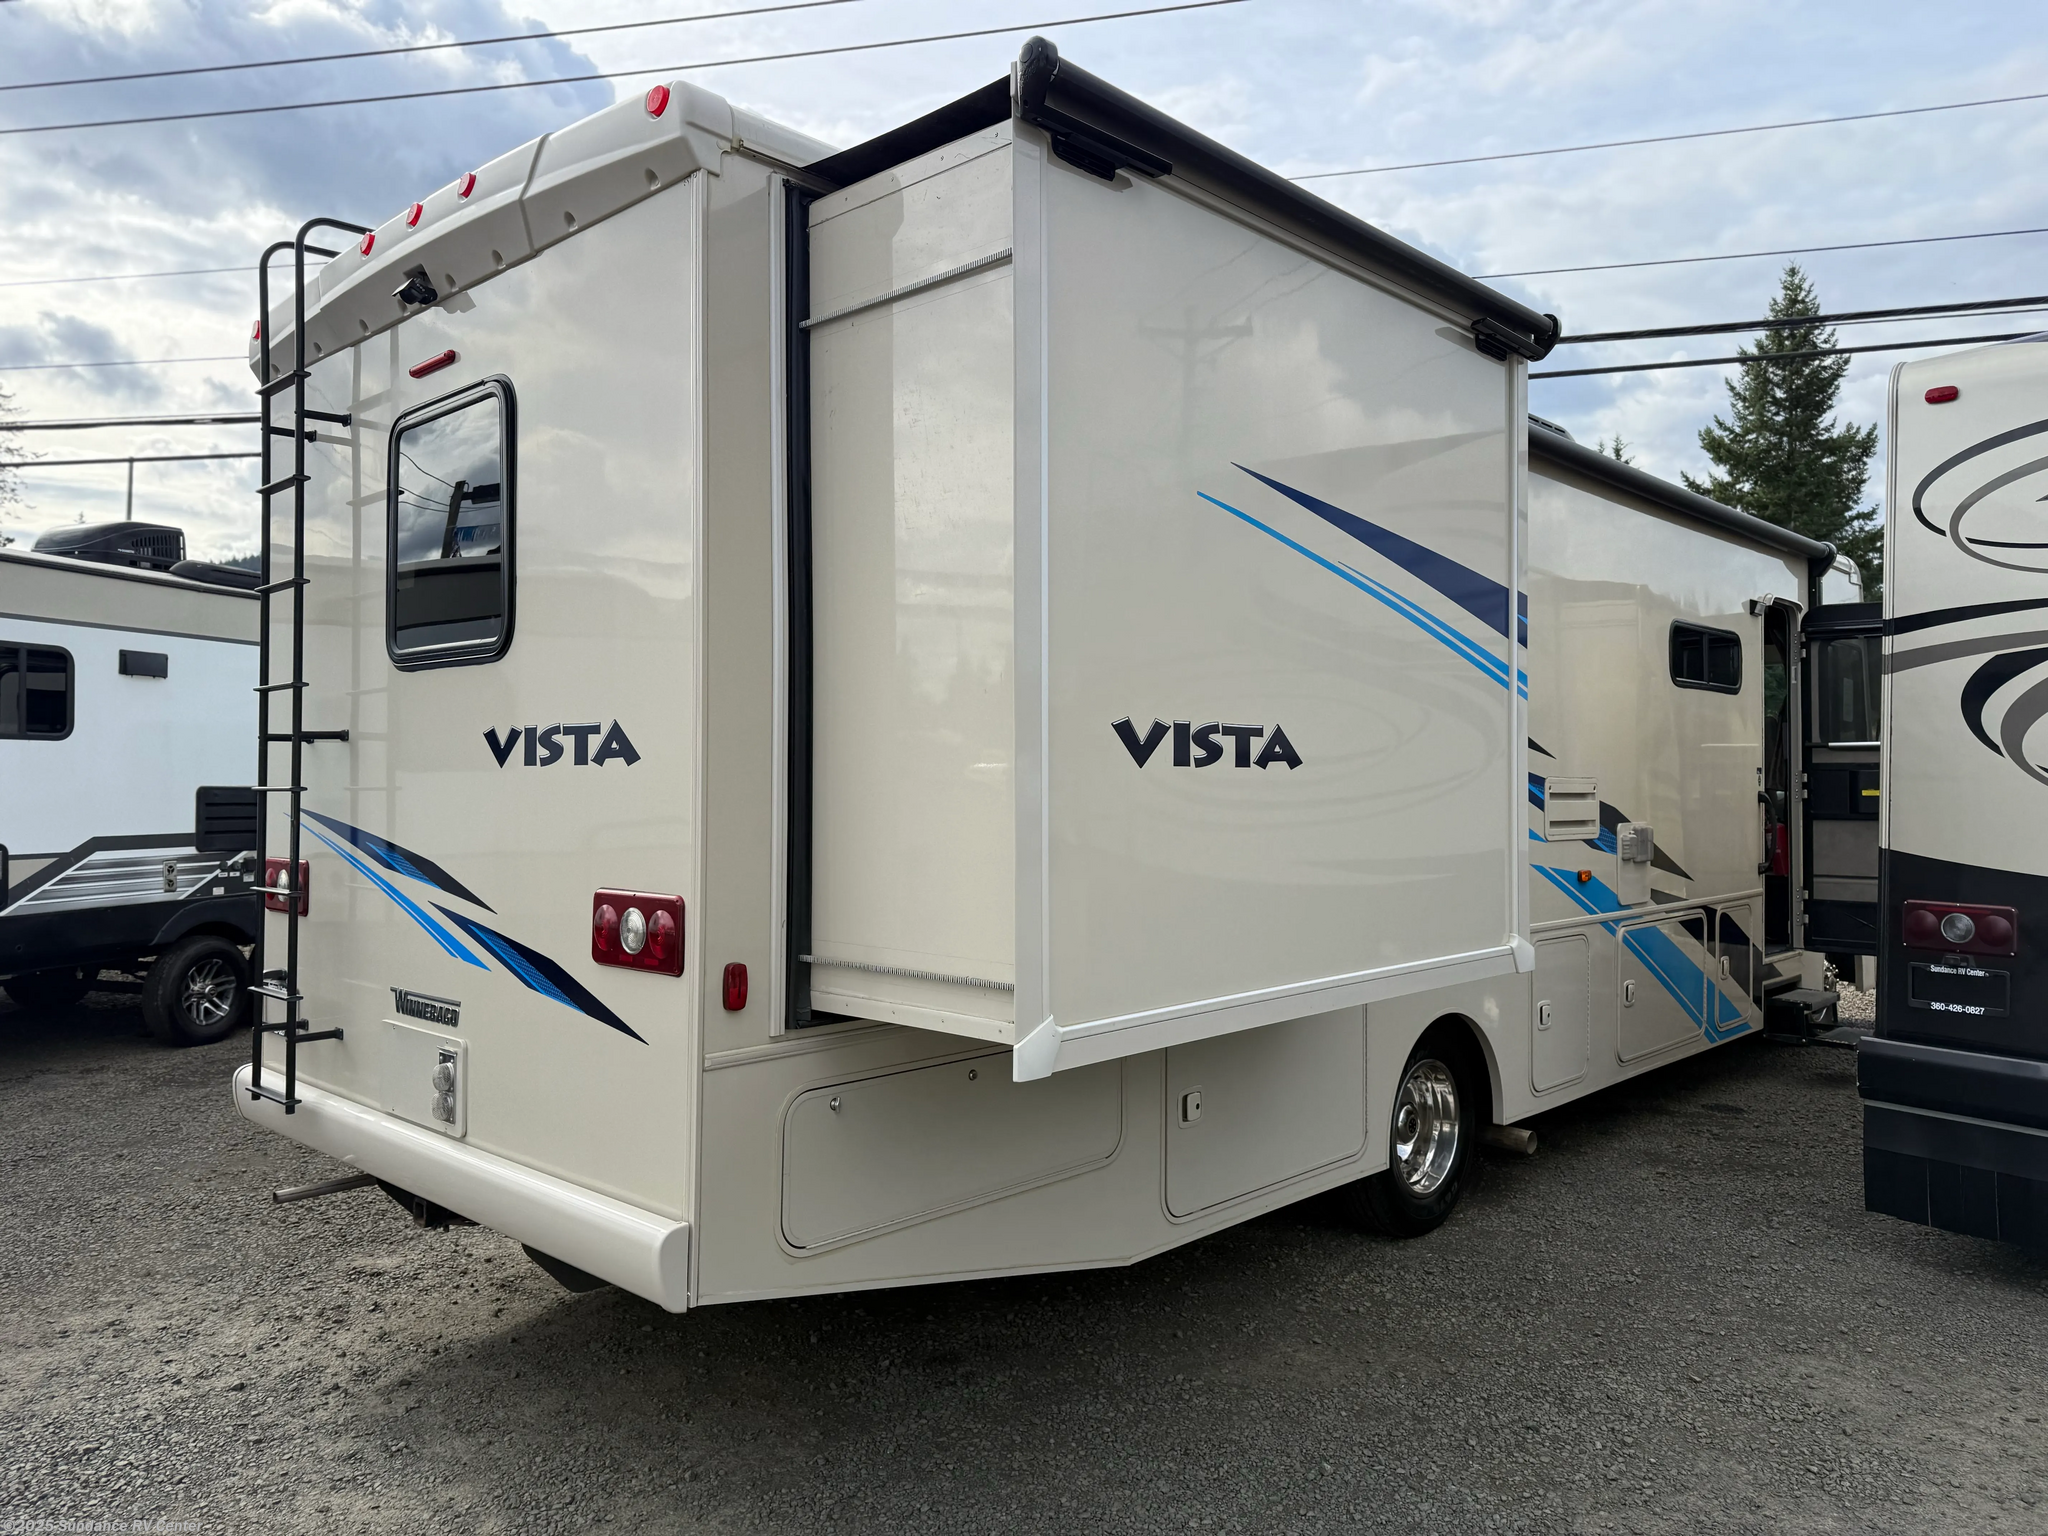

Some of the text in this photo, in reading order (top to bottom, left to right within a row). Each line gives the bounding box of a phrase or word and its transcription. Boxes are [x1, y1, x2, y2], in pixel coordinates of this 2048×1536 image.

[483, 718, 642, 769] VISTA
[1111, 716, 1304, 770] VISTA
[1930, 964, 1985, 977] Sundance RV Center
[1930, 1001, 1985, 1015] 360-426-0827
